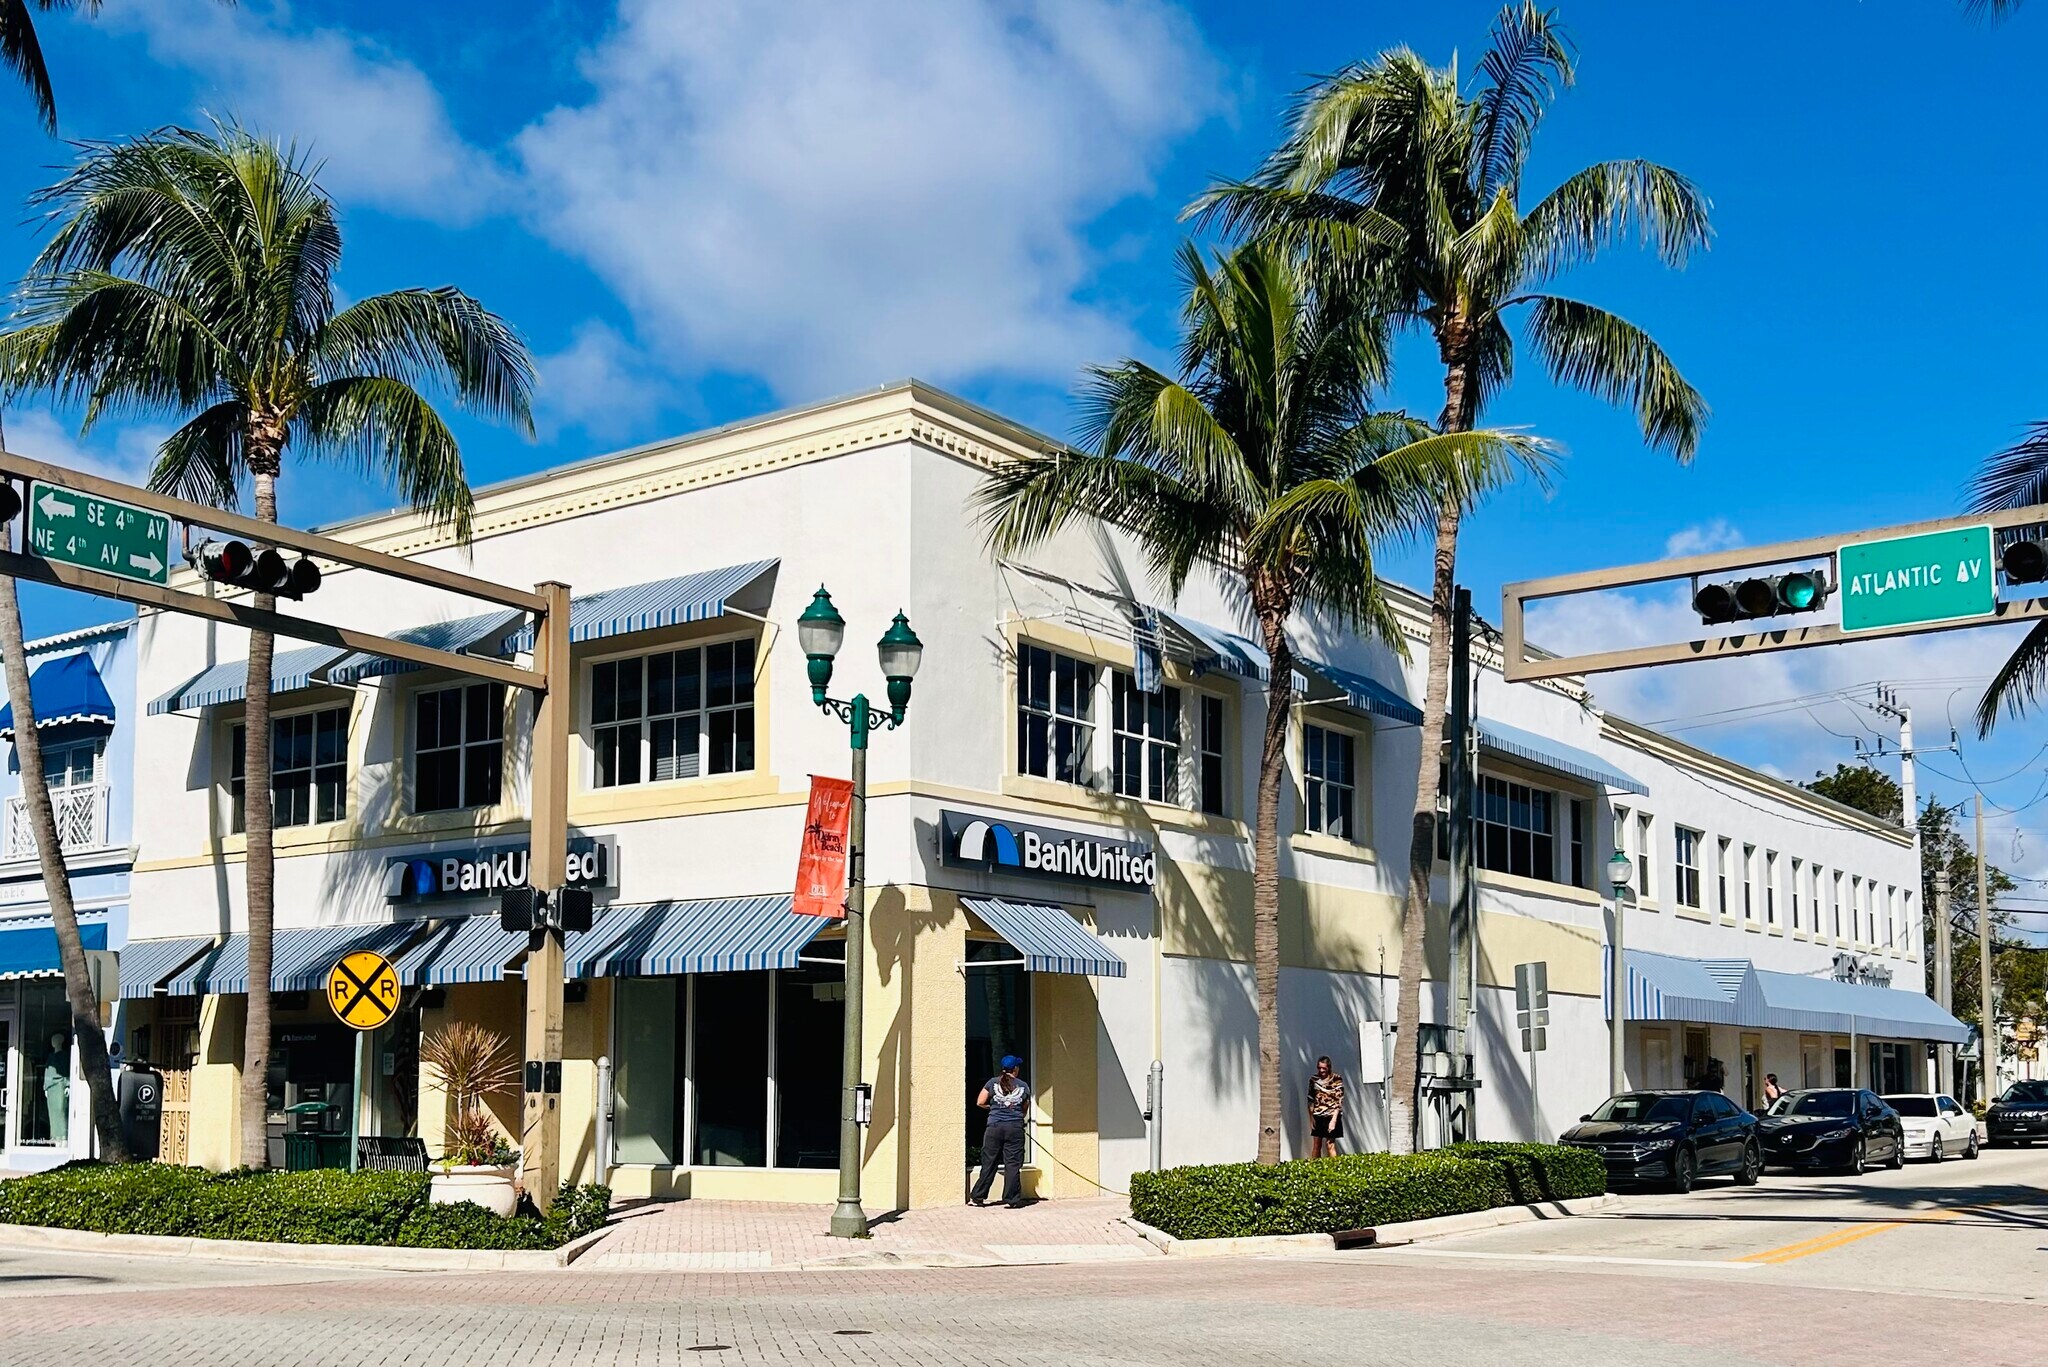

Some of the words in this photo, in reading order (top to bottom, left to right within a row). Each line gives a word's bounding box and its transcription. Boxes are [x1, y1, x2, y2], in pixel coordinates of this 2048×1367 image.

[87, 502, 106, 527] SE
[115, 510, 135, 531] 4th
[147, 518, 165, 541] AV
[36, 527, 56, 551] NE
[66, 535, 87, 556] 4th
[100, 543, 119, 566] AV
[1850, 563, 1942, 597] ATLANTIC
[1956, 558, 1982, 583] AV
[442, 842, 599, 892] BankUed
[820, 841, 845, 855] Beach
[1024, 830, 1157, 886] BankUnited
[334, 980, 349, 1000] R
[380, 979, 395, 998] R
